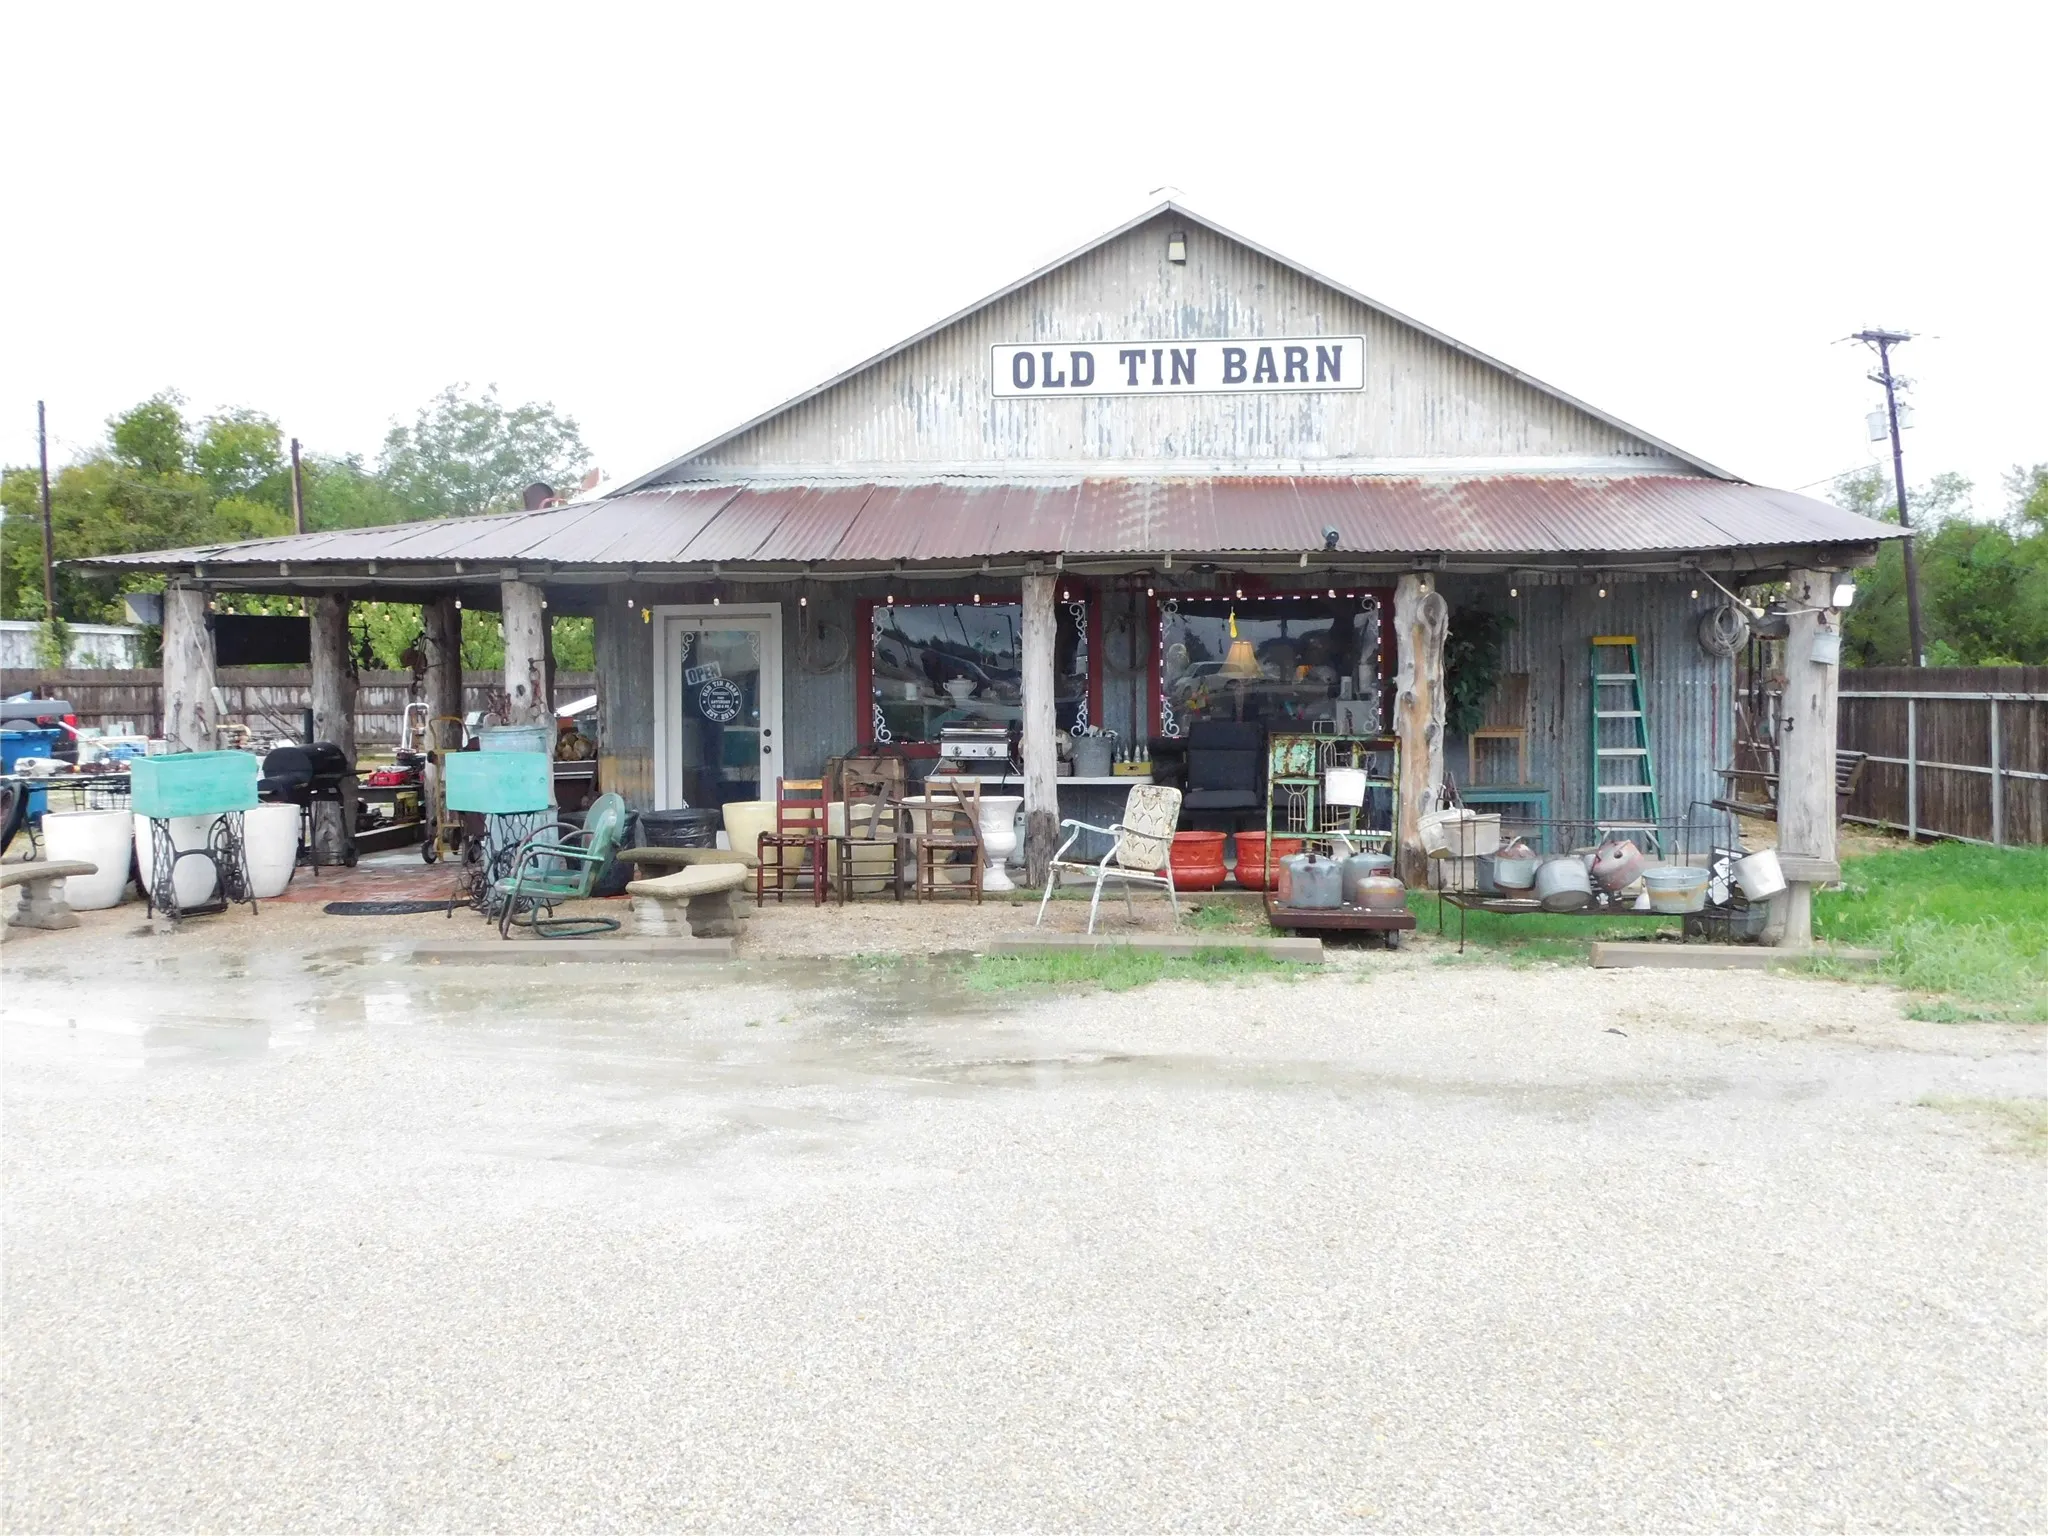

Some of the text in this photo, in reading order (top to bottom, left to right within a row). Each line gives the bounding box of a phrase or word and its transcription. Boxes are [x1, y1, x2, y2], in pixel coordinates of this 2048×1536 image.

[1012, 345, 1342, 389] OLD TIN BARN
[687, 662, 719, 684] OPEN
[702, 685, 712, 697] OLD
[725, 682, 739, 696] BARN
